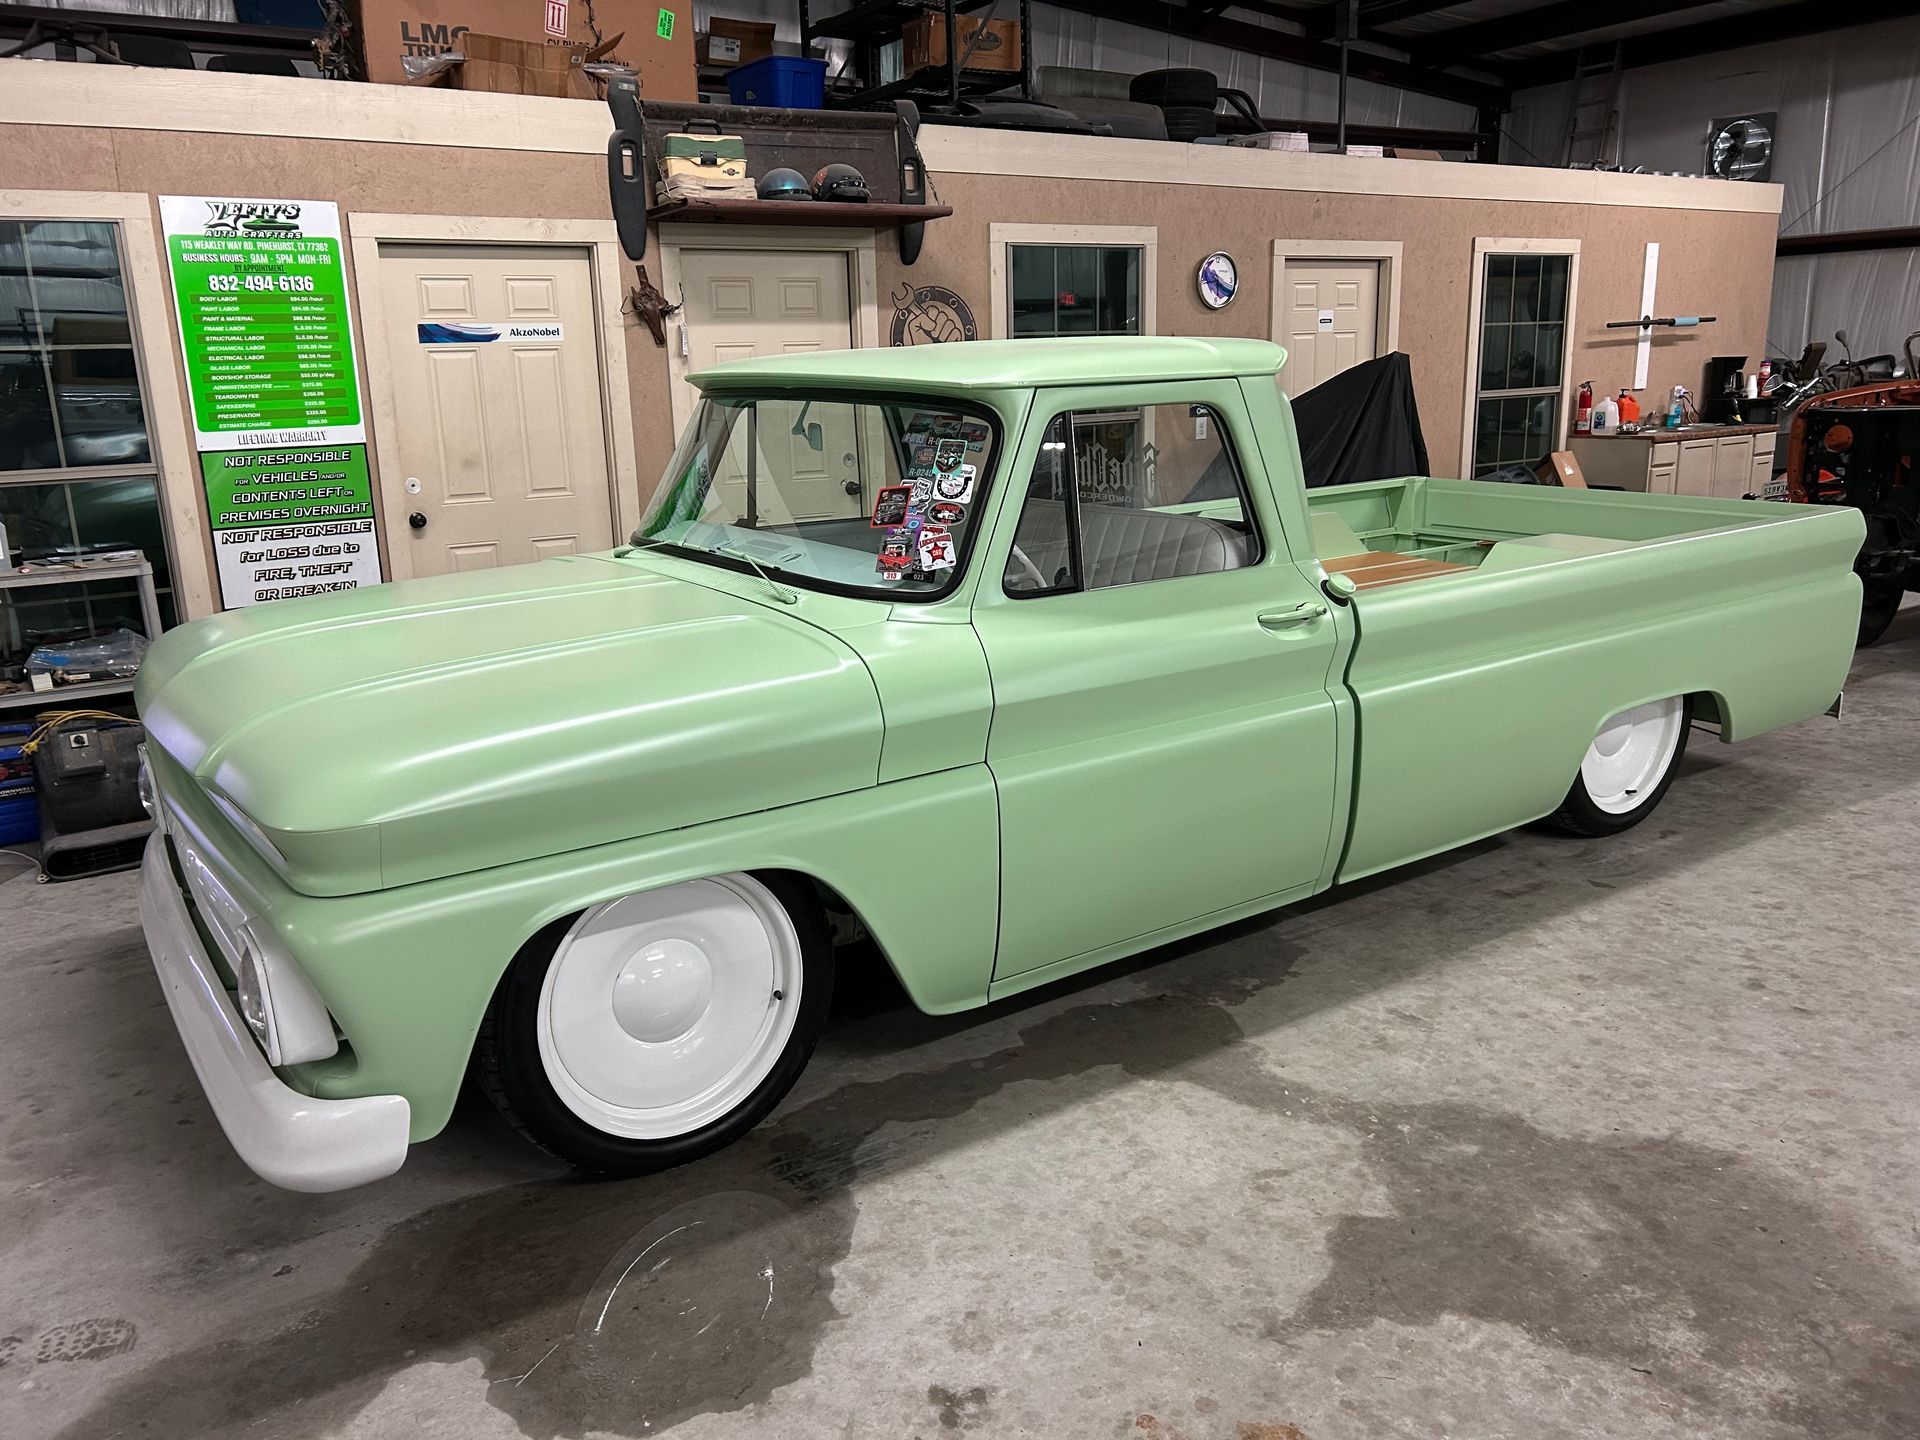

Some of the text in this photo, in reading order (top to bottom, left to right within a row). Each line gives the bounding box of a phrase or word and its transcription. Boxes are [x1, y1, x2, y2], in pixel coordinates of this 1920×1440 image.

[203, 201, 301, 230] LEFTY'S
[204, 230, 302, 240] AUTO CRAFTERS
[181, 240, 192, 249] 115
[193, 241, 226, 250] WEAKLEY
[227, 241, 242, 250] WAY
[257, 242, 297, 252] PINEHURST,
[298, 242, 306, 251] TX
[307, 242, 329, 252] 77362
[182, 253, 218, 263] BUSINESS
[220, 253, 247, 263] HOURS:
[250, 254, 268, 264] 9AM
[298, 254, 331, 265] MON-FRI
[208, 275, 314, 292] 832-494-6136
[509, 327, 560, 337] AkzoNobel
[237, 430, 327, 445] LIFETIME WARRANTY
[224, 450, 351, 468] NOT RESPONSIBLE
[252, 470, 318, 484] VEHICLES
[232, 489, 306, 504] CONTENTS
[309, 486, 343, 498] LEFT
[219, 502, 369, 524] PREMISES OVERNIGHT
[222, 522, 371, 544] NOT RESPONSIBLE
[240, 542, 360, 563] for LOSS due to
[254, 562, 352, 582] FIRE, THEFT
[255, 580, 357, 601] OR BREAK-IN
